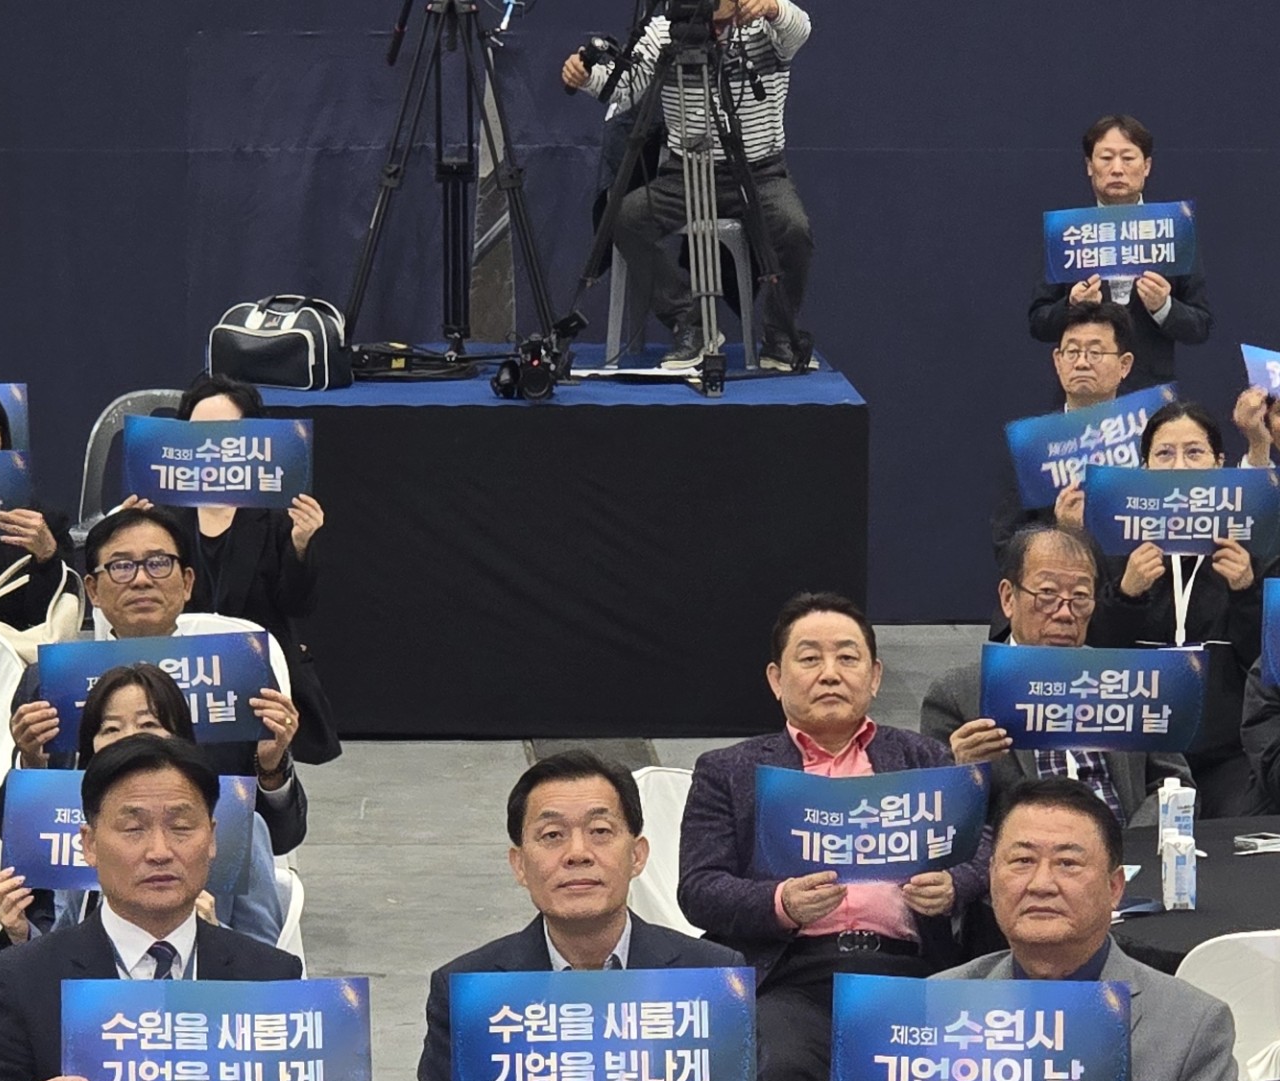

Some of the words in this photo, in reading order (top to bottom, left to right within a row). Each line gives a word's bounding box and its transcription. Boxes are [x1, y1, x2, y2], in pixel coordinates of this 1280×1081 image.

[1063, 223, 1116, 245] 수원을
[1120, 219, 1174, 242] 새롭게
[1064, 246, 1117, 269] 기업을
[1122, 242, 1175, 264] 빛나게
[1080, 408, 1148, 448] 수원시
[196, 437, 271, 462] 수원시
[150, 466, 250, 491] 기업인의
[258, 467, 283, 492] 날
[1163, 487, 1243, 513] 수원시
[1114, 515, 1222, 541] 기업인의
[1228, 516, 1254, 541] 날
[157, 656, 221, 687] 원시
[1029, 681, 1066, 697] 제3회
[1070, 670, 1159, 700] 수원시
[207, 694, 238, 722] 날
[1016, 703, 1133, 734] 기업인의
[1142, 704, 1172, 734] 날
[804, 809, 843, 826] 제3회
[848, 791, 943, 830] 수원시
[791, 828, 918, 865] 기업인의
[927, 827, 956, 861] 날
[102, 1010, 209, 1052] 수원을
[219, 1010, 324, 1051] 새롭게
[488, 1004, 596, 1044] 수원을
[604, 1000, 710, 1040] 새롭게
[890, 1025, 939, 1046] 제3회
[944, 1009, 1064, 1051] 수원시
